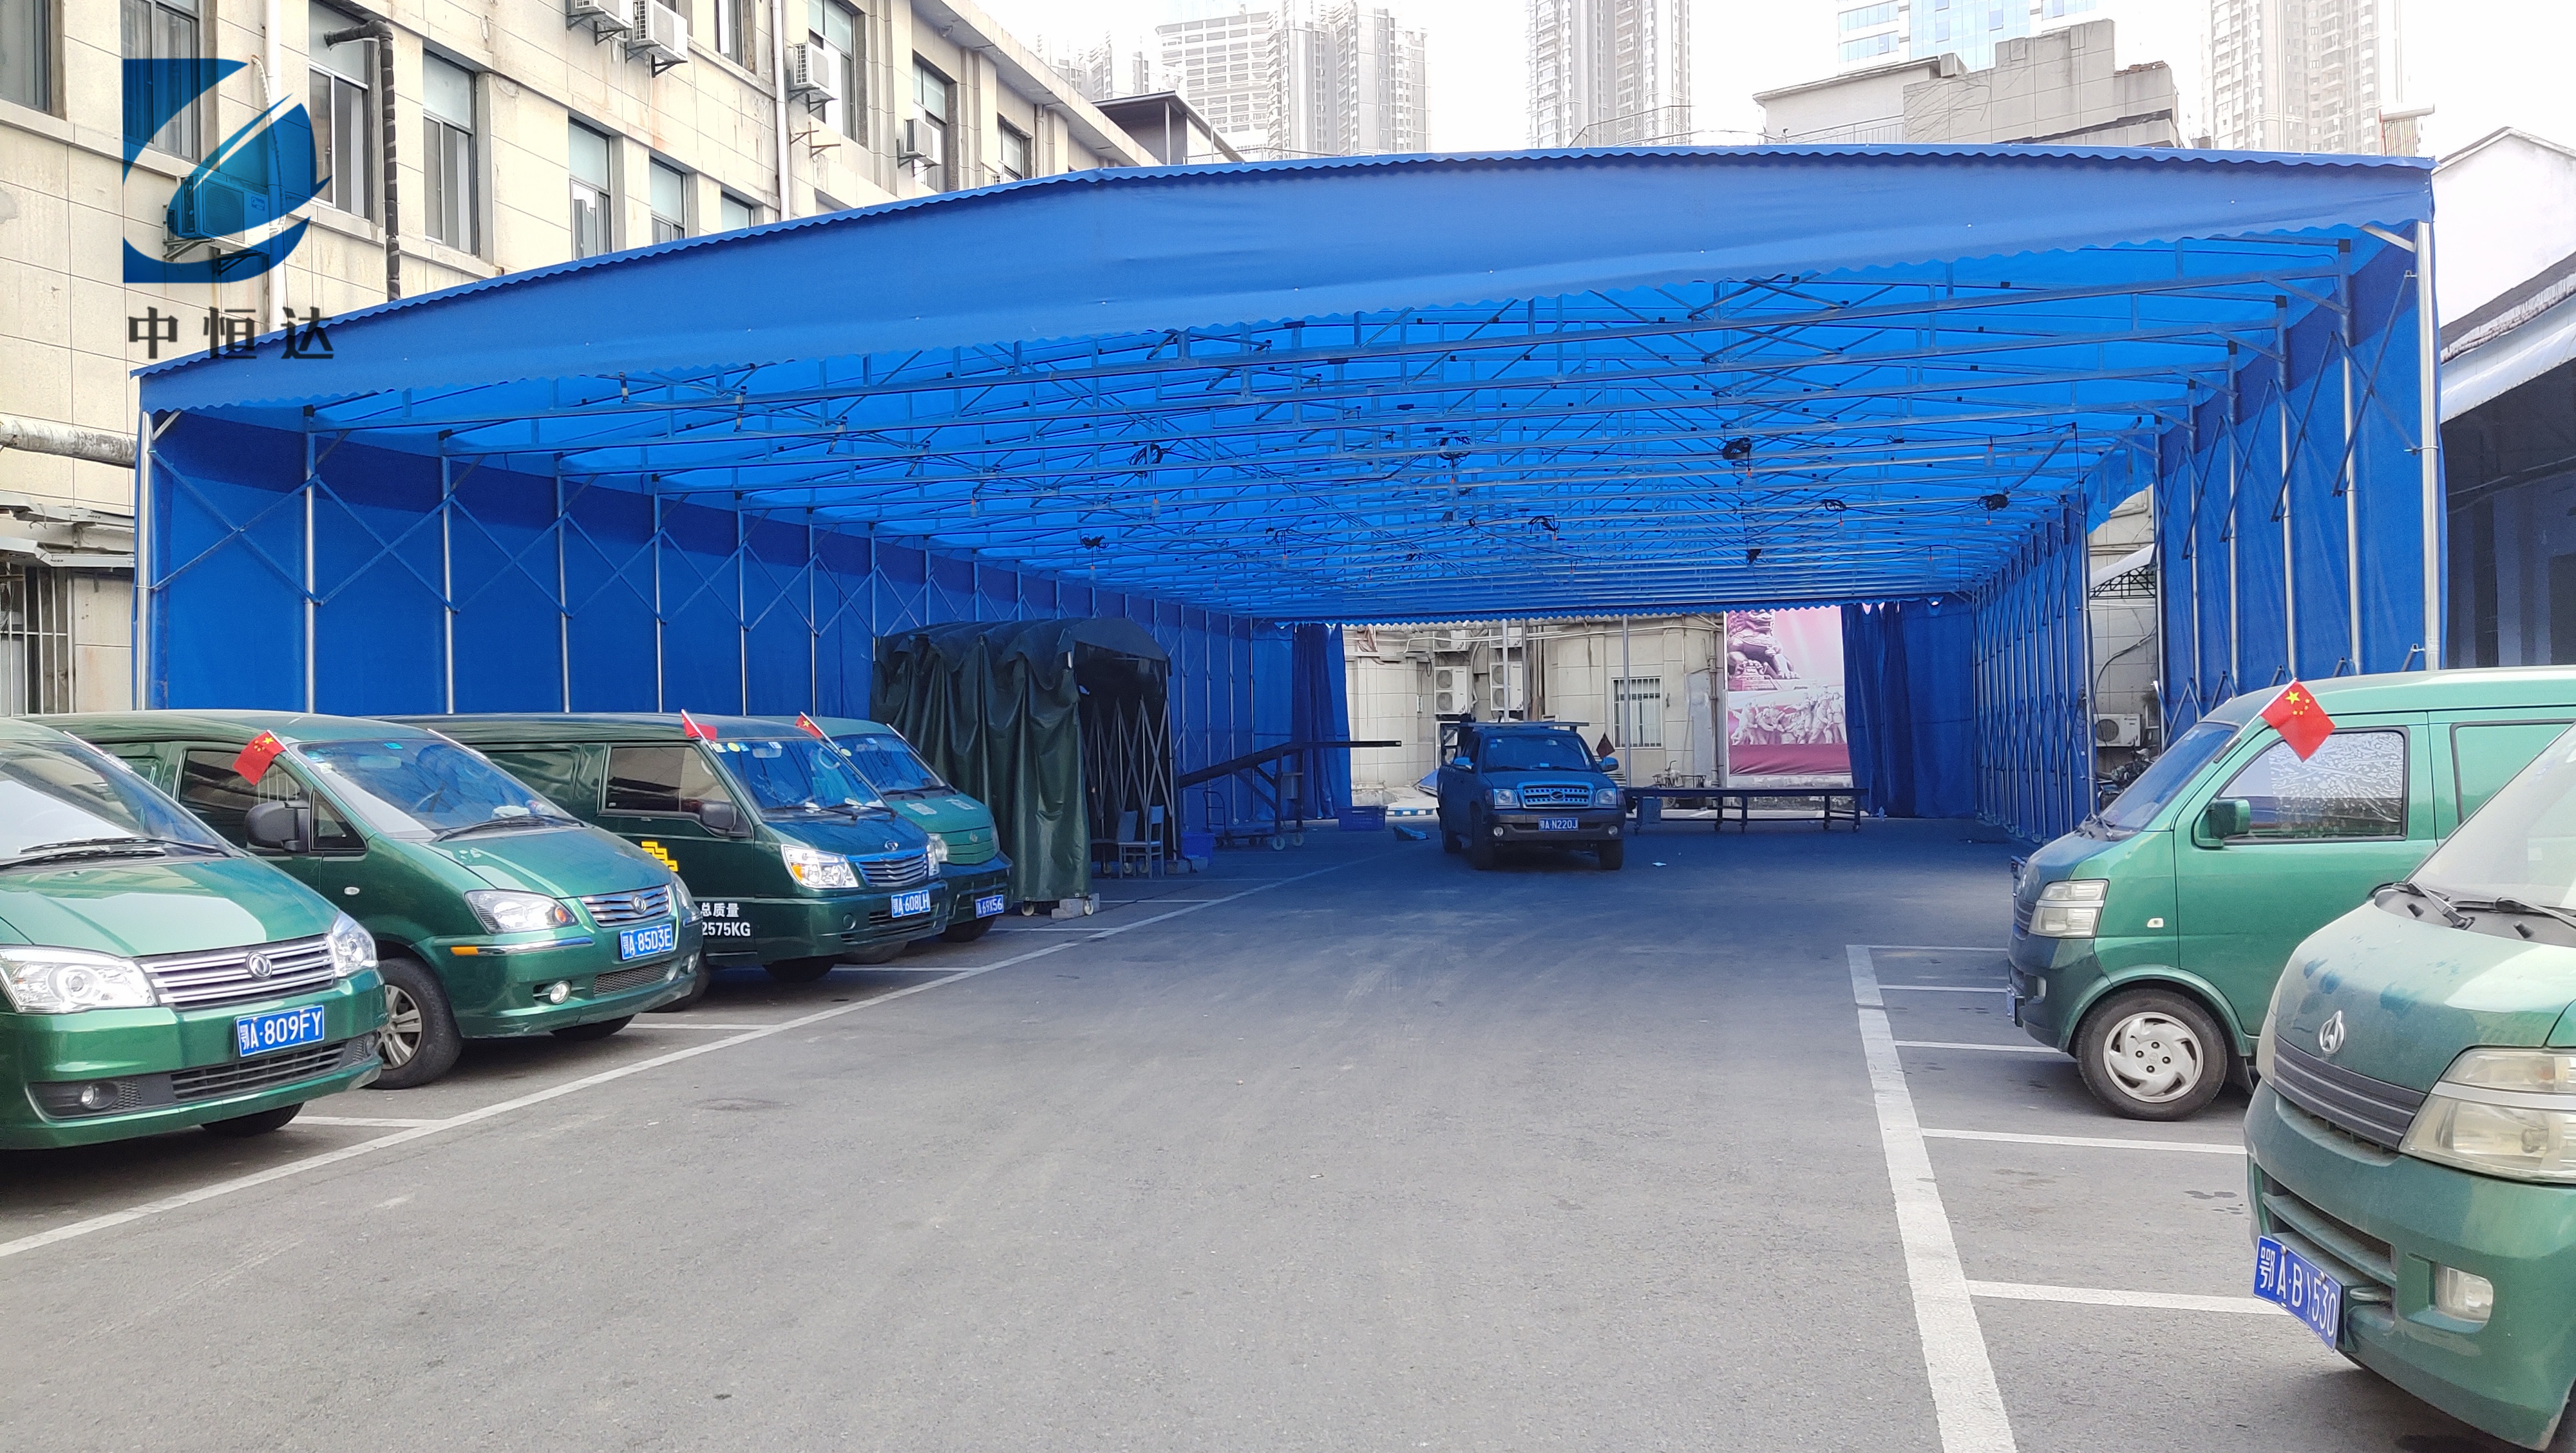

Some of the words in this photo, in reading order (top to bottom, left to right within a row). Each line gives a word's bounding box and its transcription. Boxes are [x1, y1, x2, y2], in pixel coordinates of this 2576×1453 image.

[701, 902, 739, 917] 总质量
[702, 922, 751, 936] 2575KG
